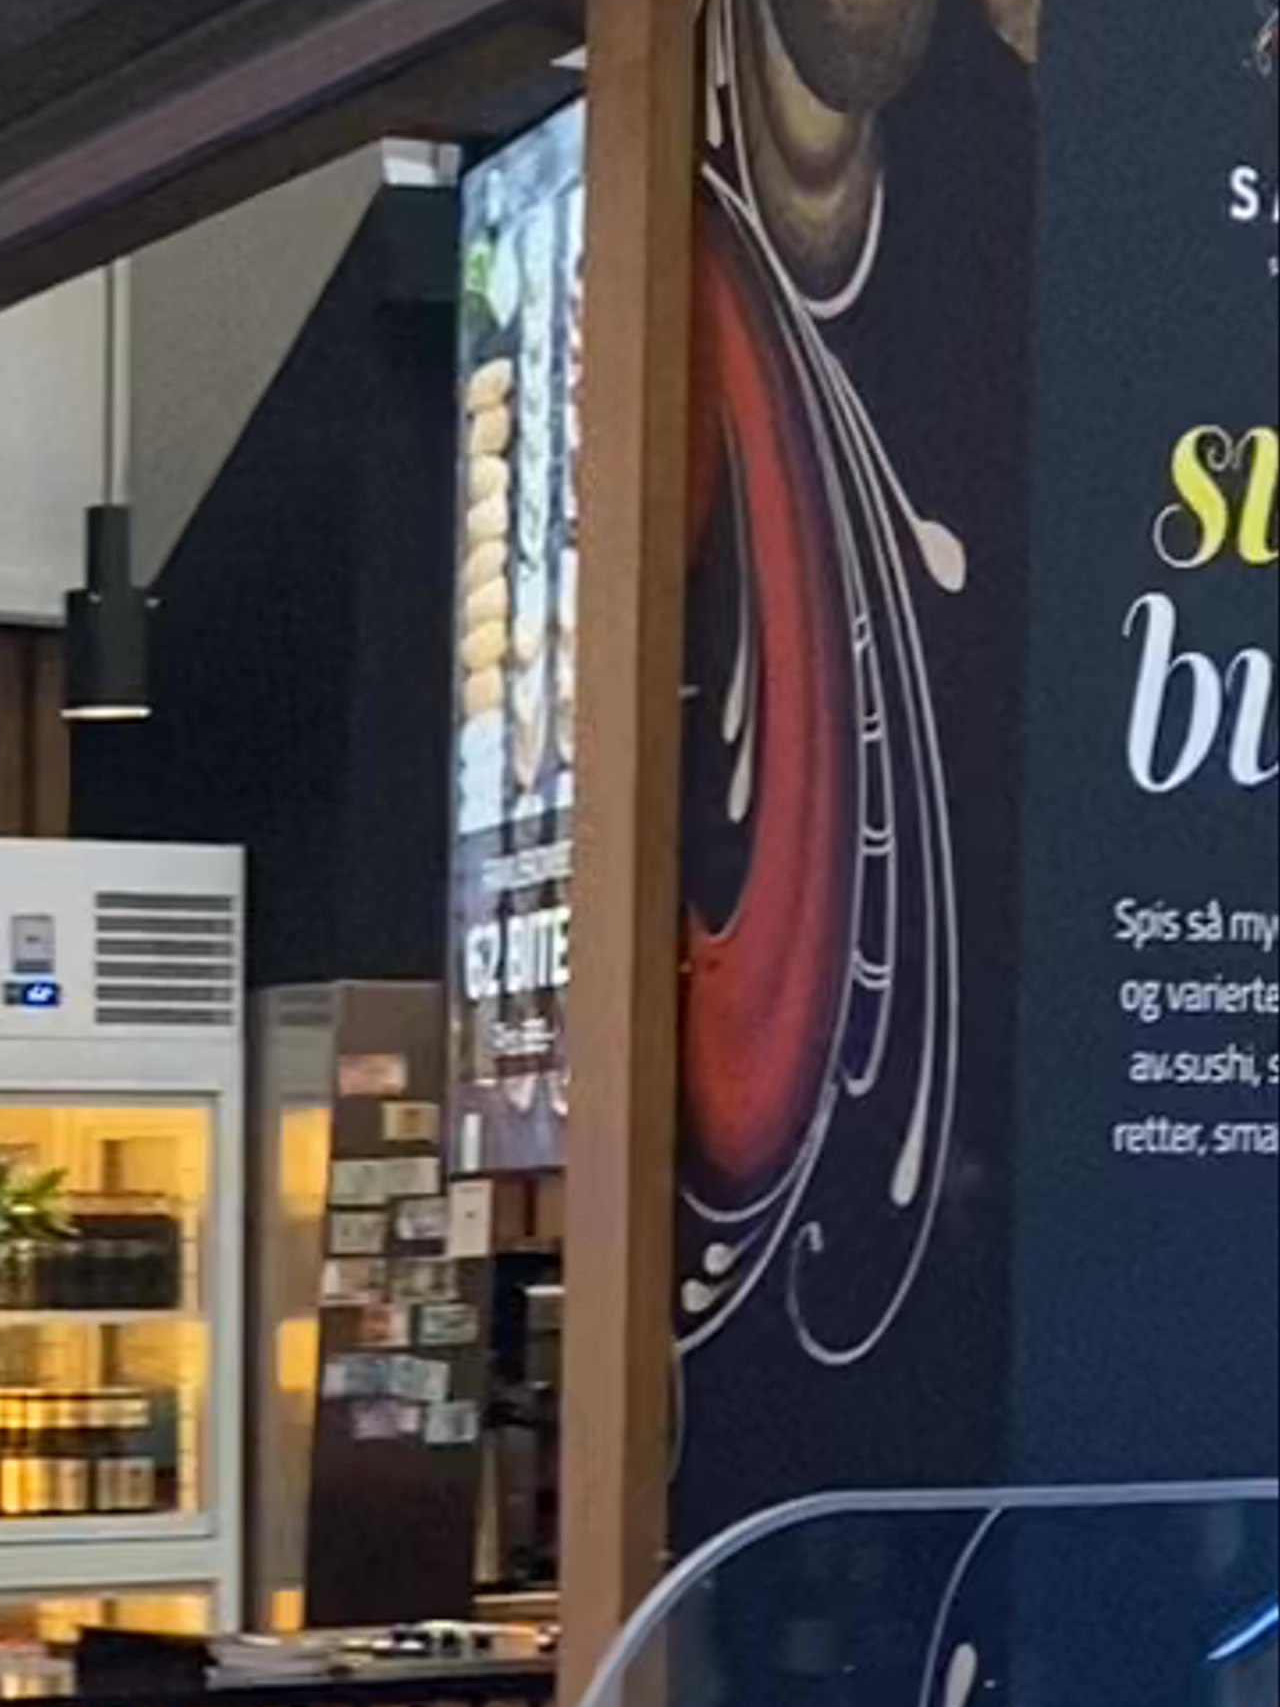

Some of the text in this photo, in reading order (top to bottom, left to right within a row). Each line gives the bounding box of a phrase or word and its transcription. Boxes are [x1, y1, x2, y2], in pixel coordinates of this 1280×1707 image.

[1113, 896, 1180, 950] Spis
[1186, 898, 1223, 941] så
[1119, 971, 1278, 1023] og varierte
[1172, 1043, 1262, 1088] sushi,
[1113, 1113, 1208, 1156] retter,
